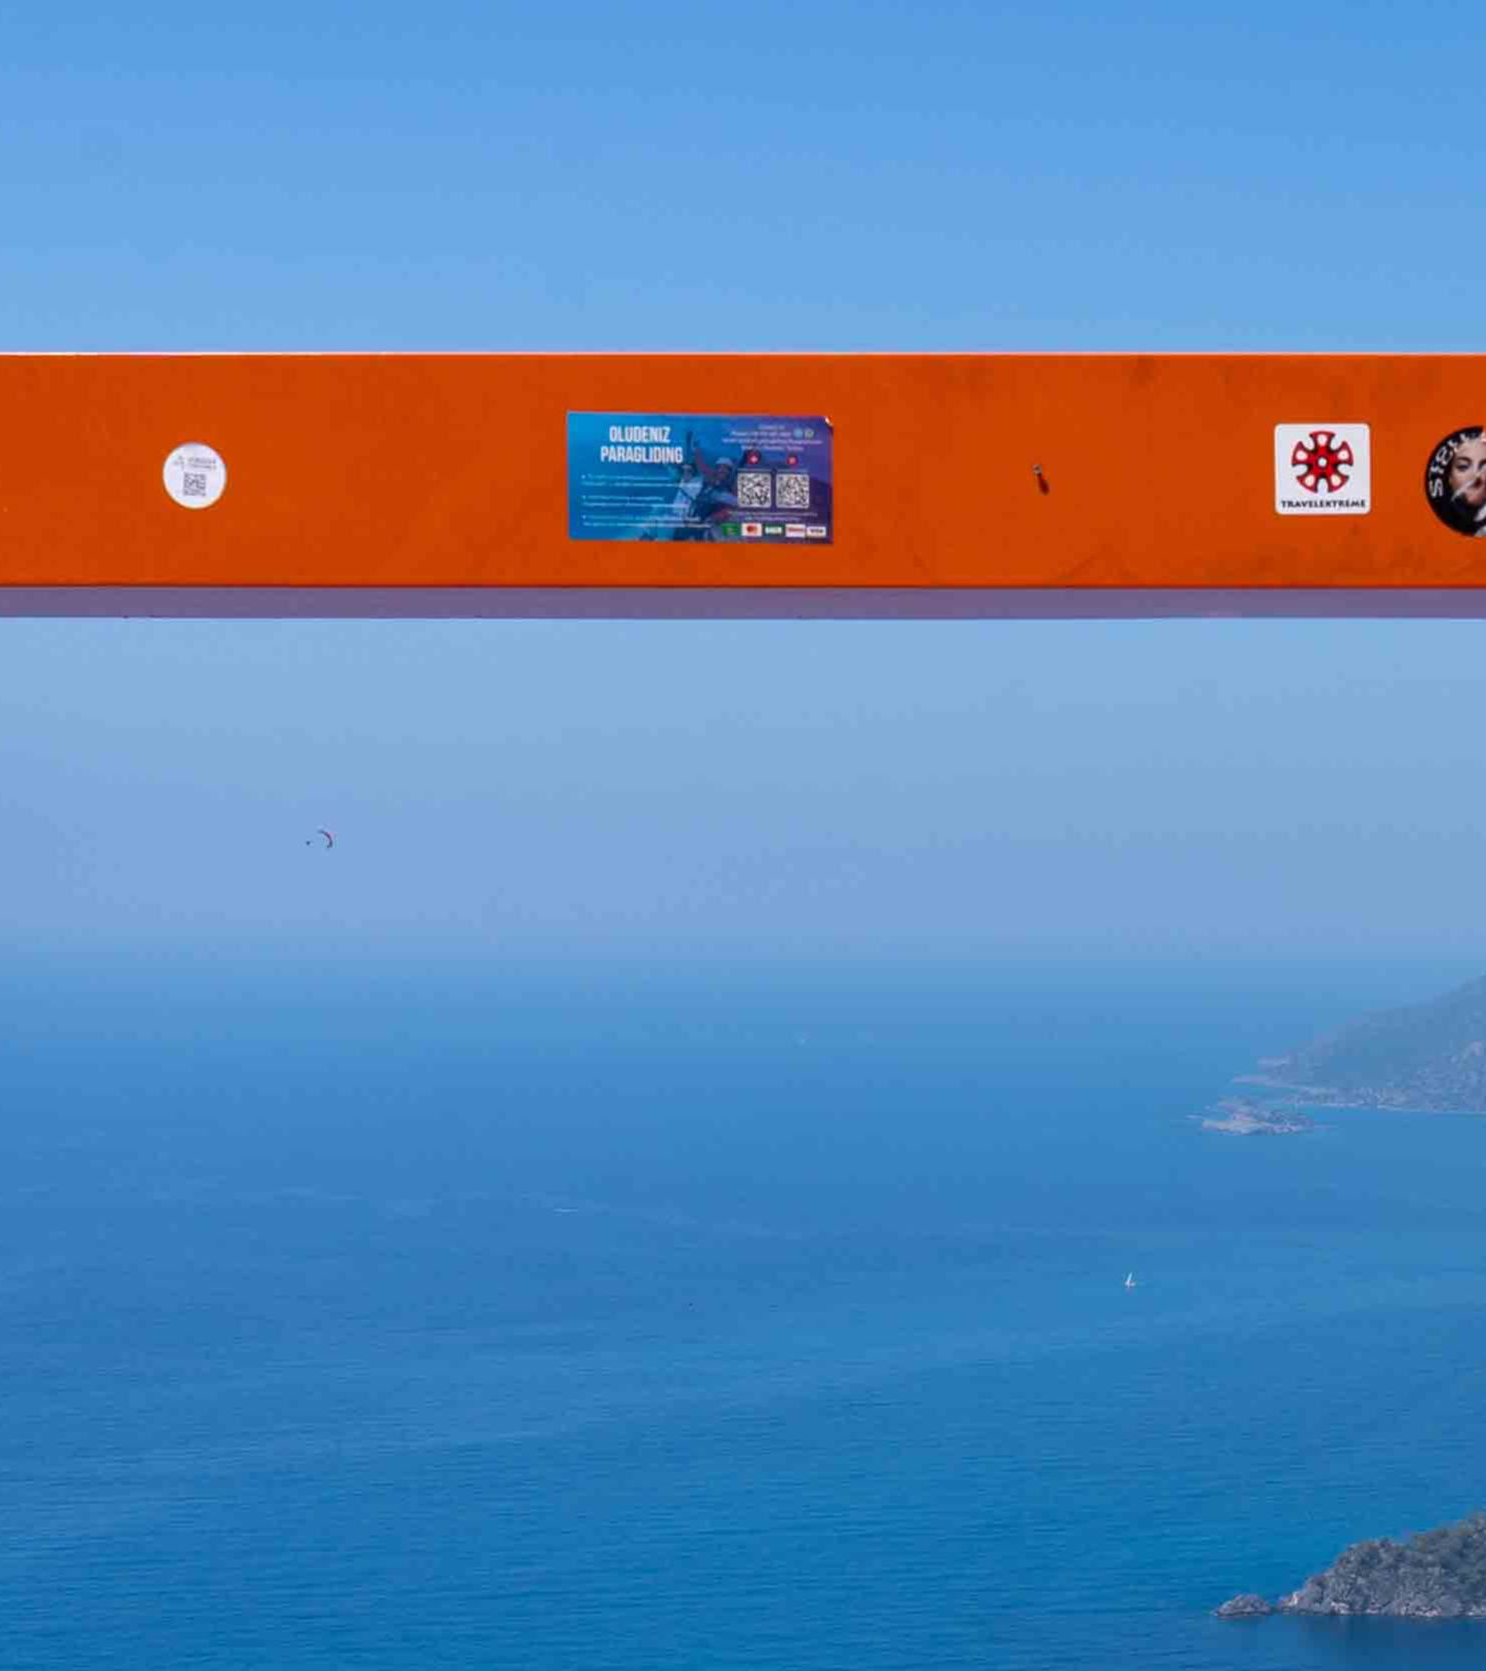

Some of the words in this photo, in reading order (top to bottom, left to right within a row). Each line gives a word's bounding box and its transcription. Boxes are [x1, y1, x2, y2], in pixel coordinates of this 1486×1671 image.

[609, 426, 671, 443] OLUDENIZ
[600, 446, 684, 463] PARAGLIDING
[1281, 500, 1365, 508] TRAVELEXTREME
